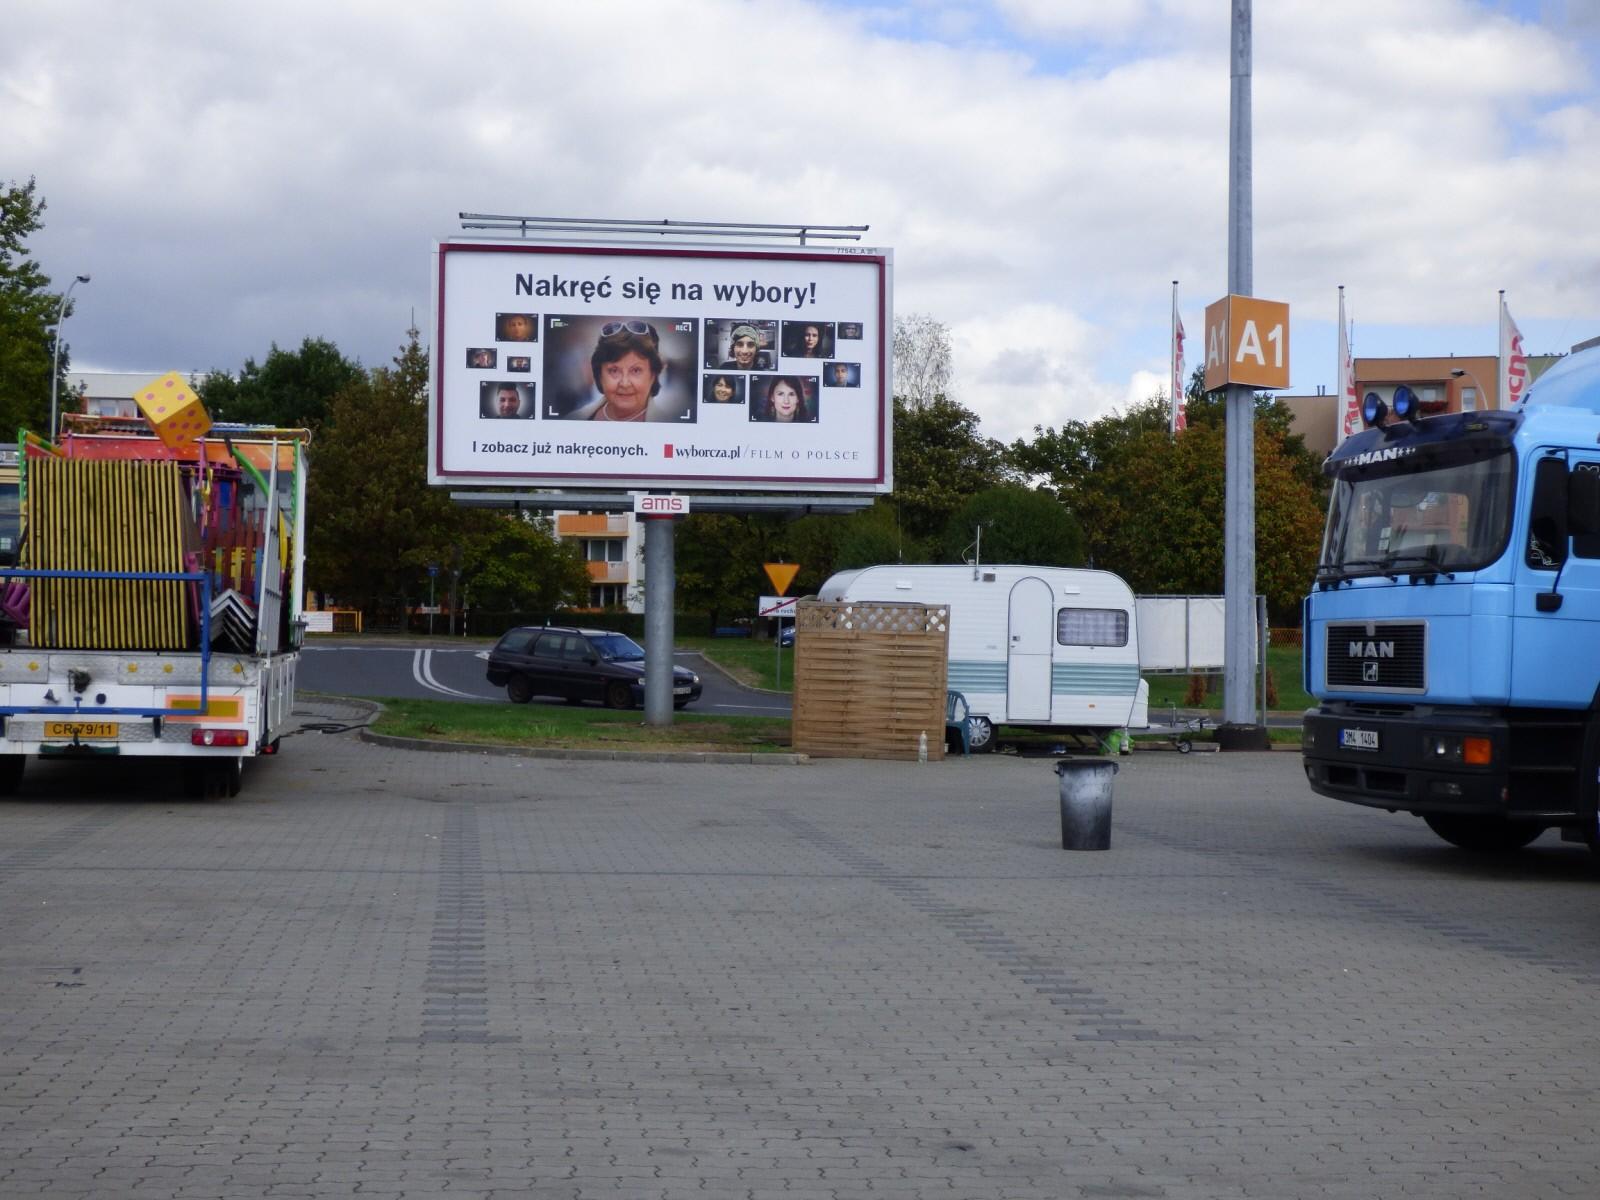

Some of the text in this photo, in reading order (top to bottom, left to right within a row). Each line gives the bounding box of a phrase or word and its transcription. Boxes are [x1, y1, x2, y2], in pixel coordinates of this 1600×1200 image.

[515, 273, 817, 309] Nakręć się na wybory!
[1207, 319, 1226, 370] A1
[1235, 319, 1283, 368] A1
[472, 441, 648, 458] I zobacz już nakręconych.
[676, 445, 741, 460] wyborcza.pl
[750, 449, 783, 459] FILM
[791, 450, 800, 459] O
[807, 451, 859, 460] POLSCE
[1359, 447, 1398, 465] MAN
[641, 497, 682, 511] ams
[1349, 641, 1395, 658] MAN
[1360, 732, 1376, 746] 1404
